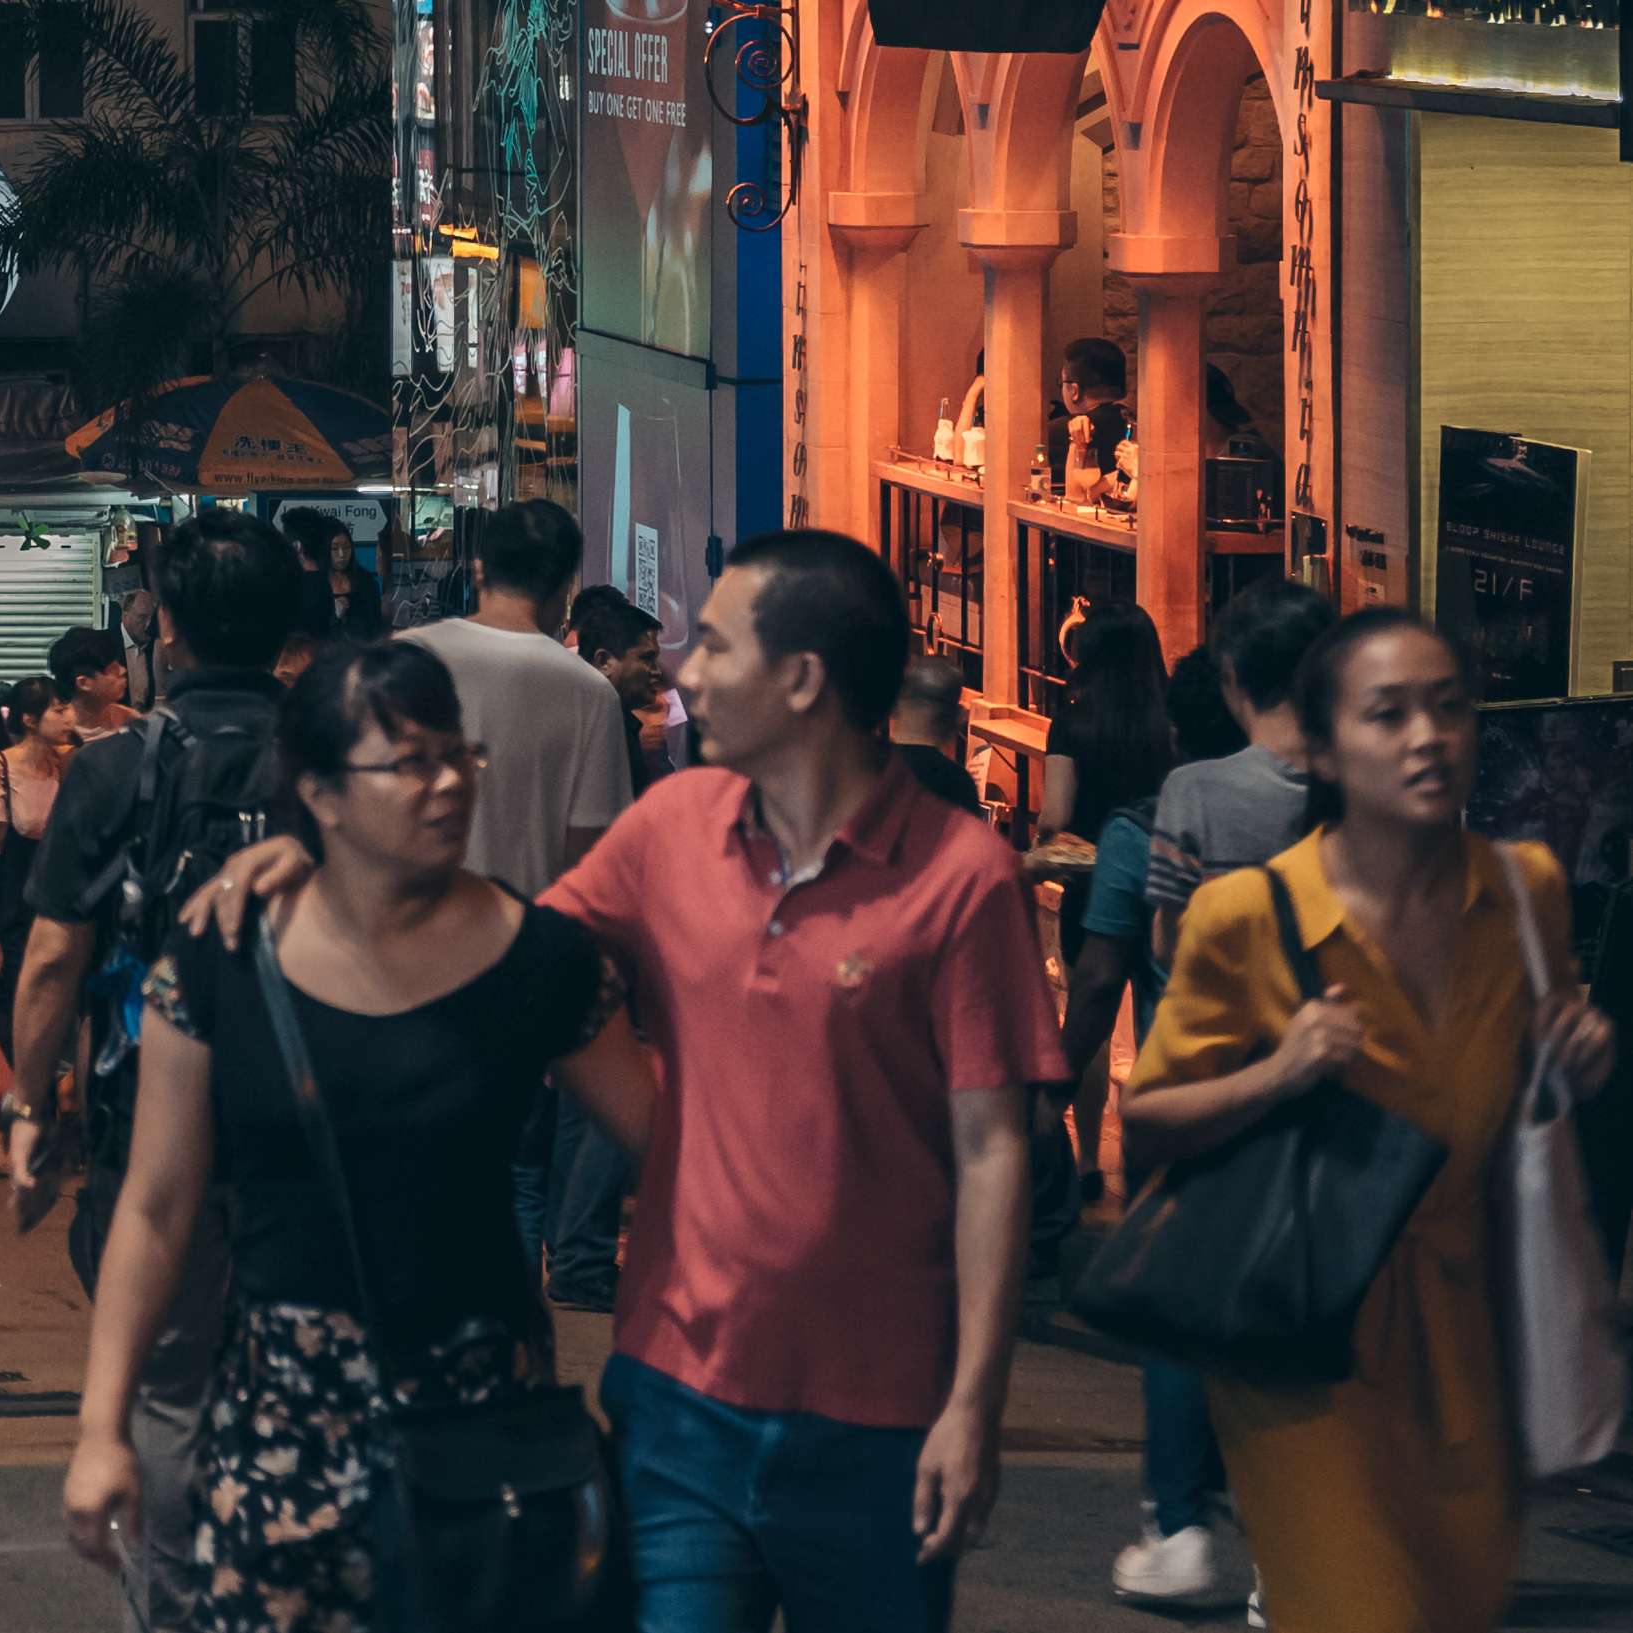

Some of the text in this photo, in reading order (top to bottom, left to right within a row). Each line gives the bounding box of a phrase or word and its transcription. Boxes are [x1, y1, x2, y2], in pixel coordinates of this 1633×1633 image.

[588, 27, 668, 84] SPECIAL OFFER
[588, 90, 686, 128] BUY ONE GET ONE FREE
[789, 263, 808, 529] insom
[345, 505, 378, 520] Fong
[1472, 567, 1536, 602] 21/F
